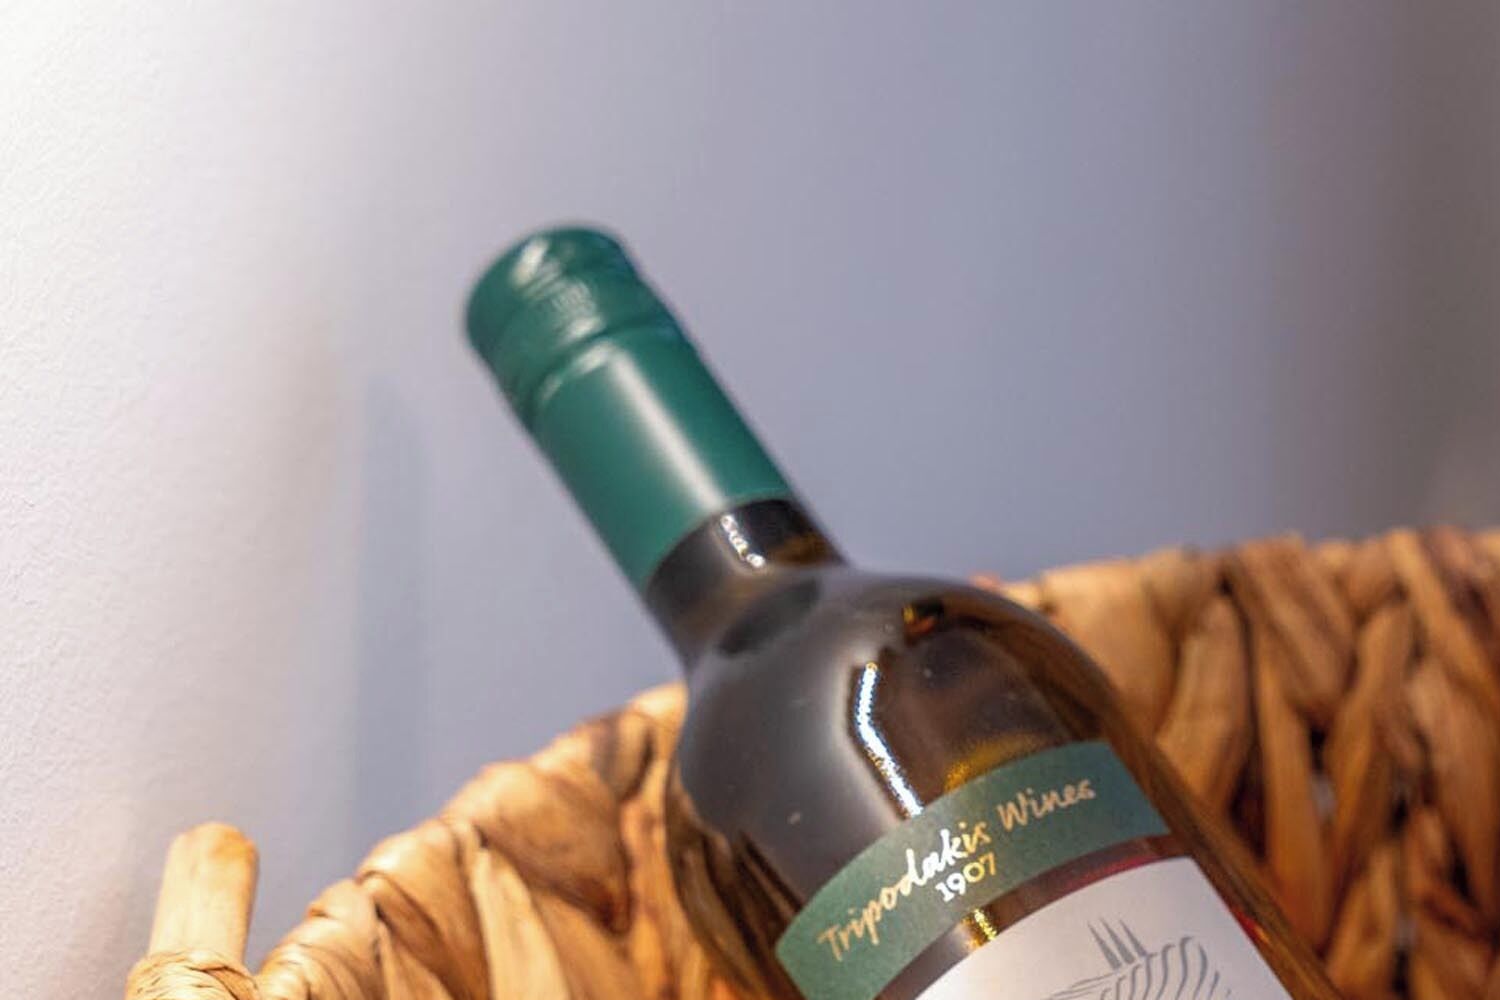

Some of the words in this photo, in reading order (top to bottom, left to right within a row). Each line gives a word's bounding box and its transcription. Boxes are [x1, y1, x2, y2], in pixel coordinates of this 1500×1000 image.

[818, 820, 992, 961] Tripodakis
[997, 778, 1096, 831] Wines
[936, 851, 996, 902] 1907
